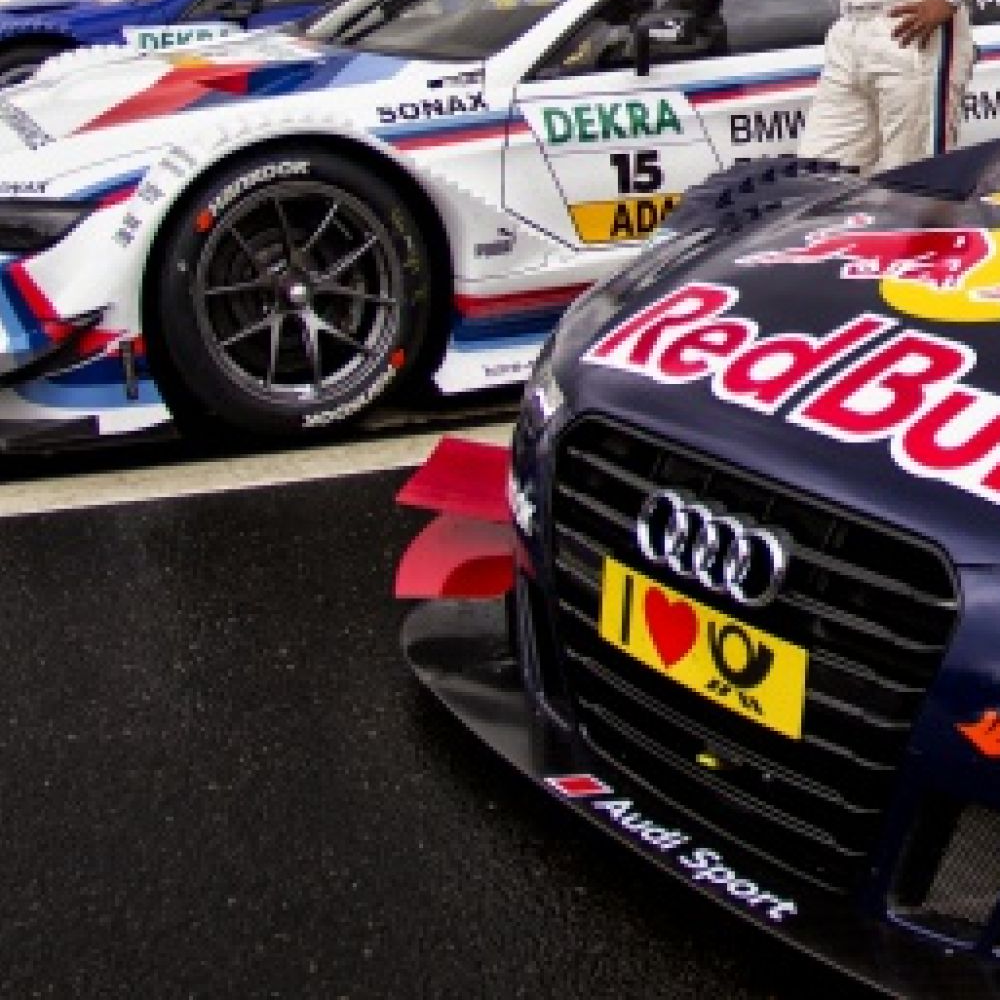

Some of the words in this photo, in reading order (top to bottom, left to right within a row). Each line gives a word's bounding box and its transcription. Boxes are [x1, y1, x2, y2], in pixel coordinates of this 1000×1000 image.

[376, 92, 488, 123] SONAX
[543, 99, 683, 144] DEKRA
[731, 110, 805, 143] BMW
[610, 150, 664, 194] 15
[581, 281, 890, 415] Red
[601, 799, 689, 851] Audi
[679, 846, 799, 922] Sport
